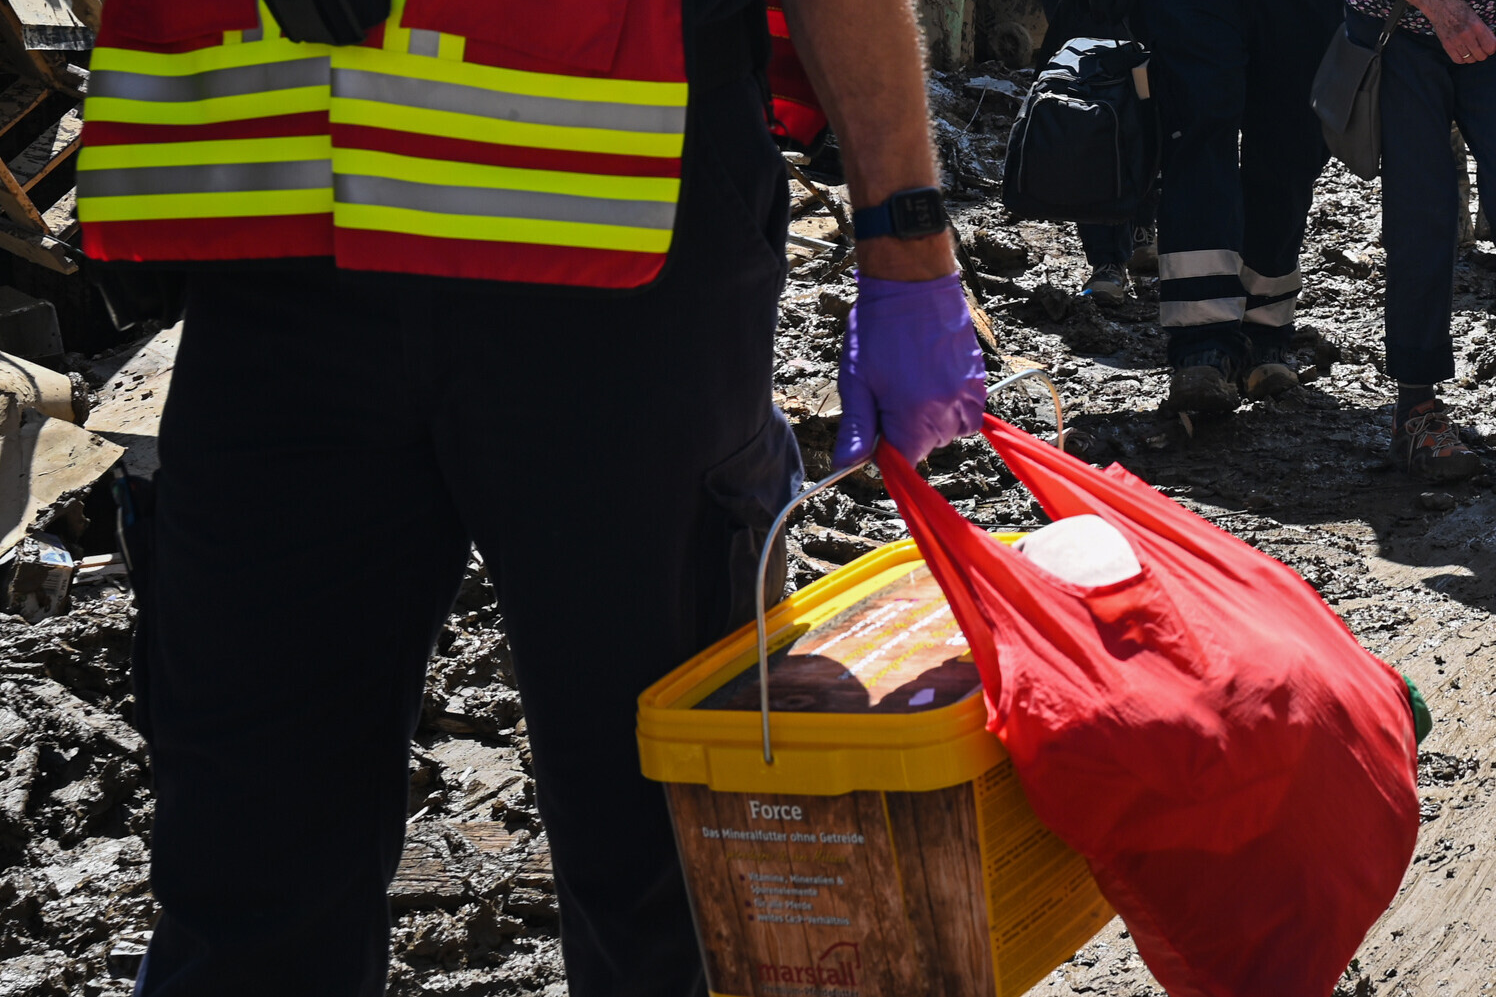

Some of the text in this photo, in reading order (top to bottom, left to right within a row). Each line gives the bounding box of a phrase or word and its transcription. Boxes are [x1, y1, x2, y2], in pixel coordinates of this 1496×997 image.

[749, 801, 802, 820] Force
[702, 826, 865, 844] Das Mineralfutter ohne Getreide
[757, 961, 858, 986] marstall
